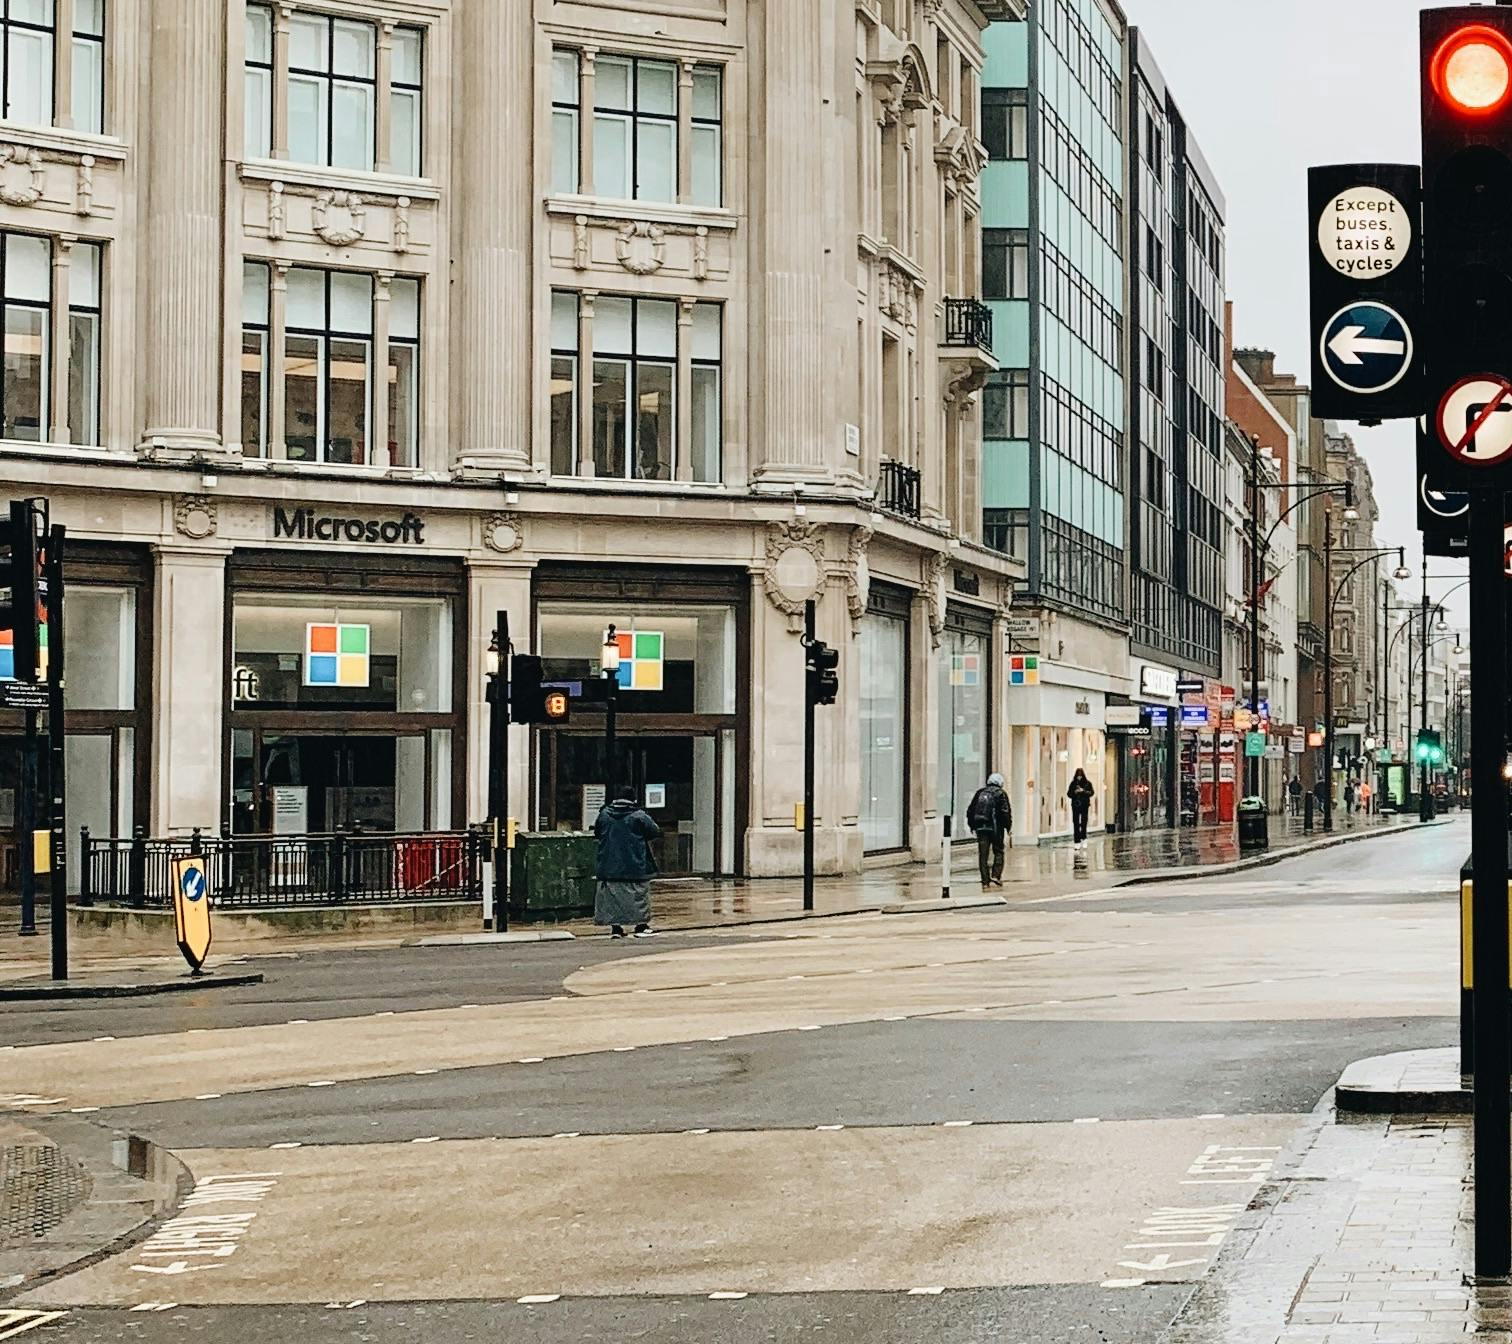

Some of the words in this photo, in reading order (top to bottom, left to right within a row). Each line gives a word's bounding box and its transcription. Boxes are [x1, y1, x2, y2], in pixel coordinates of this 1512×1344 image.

[1335, 199, 1395, 213] Except
[1336, 236, 1379, 250] taxis
[1384, 236, 1395, 250] &
[1336, 256, 1393, 272] cycles
[273, 507, 425, 544] Microsoft
